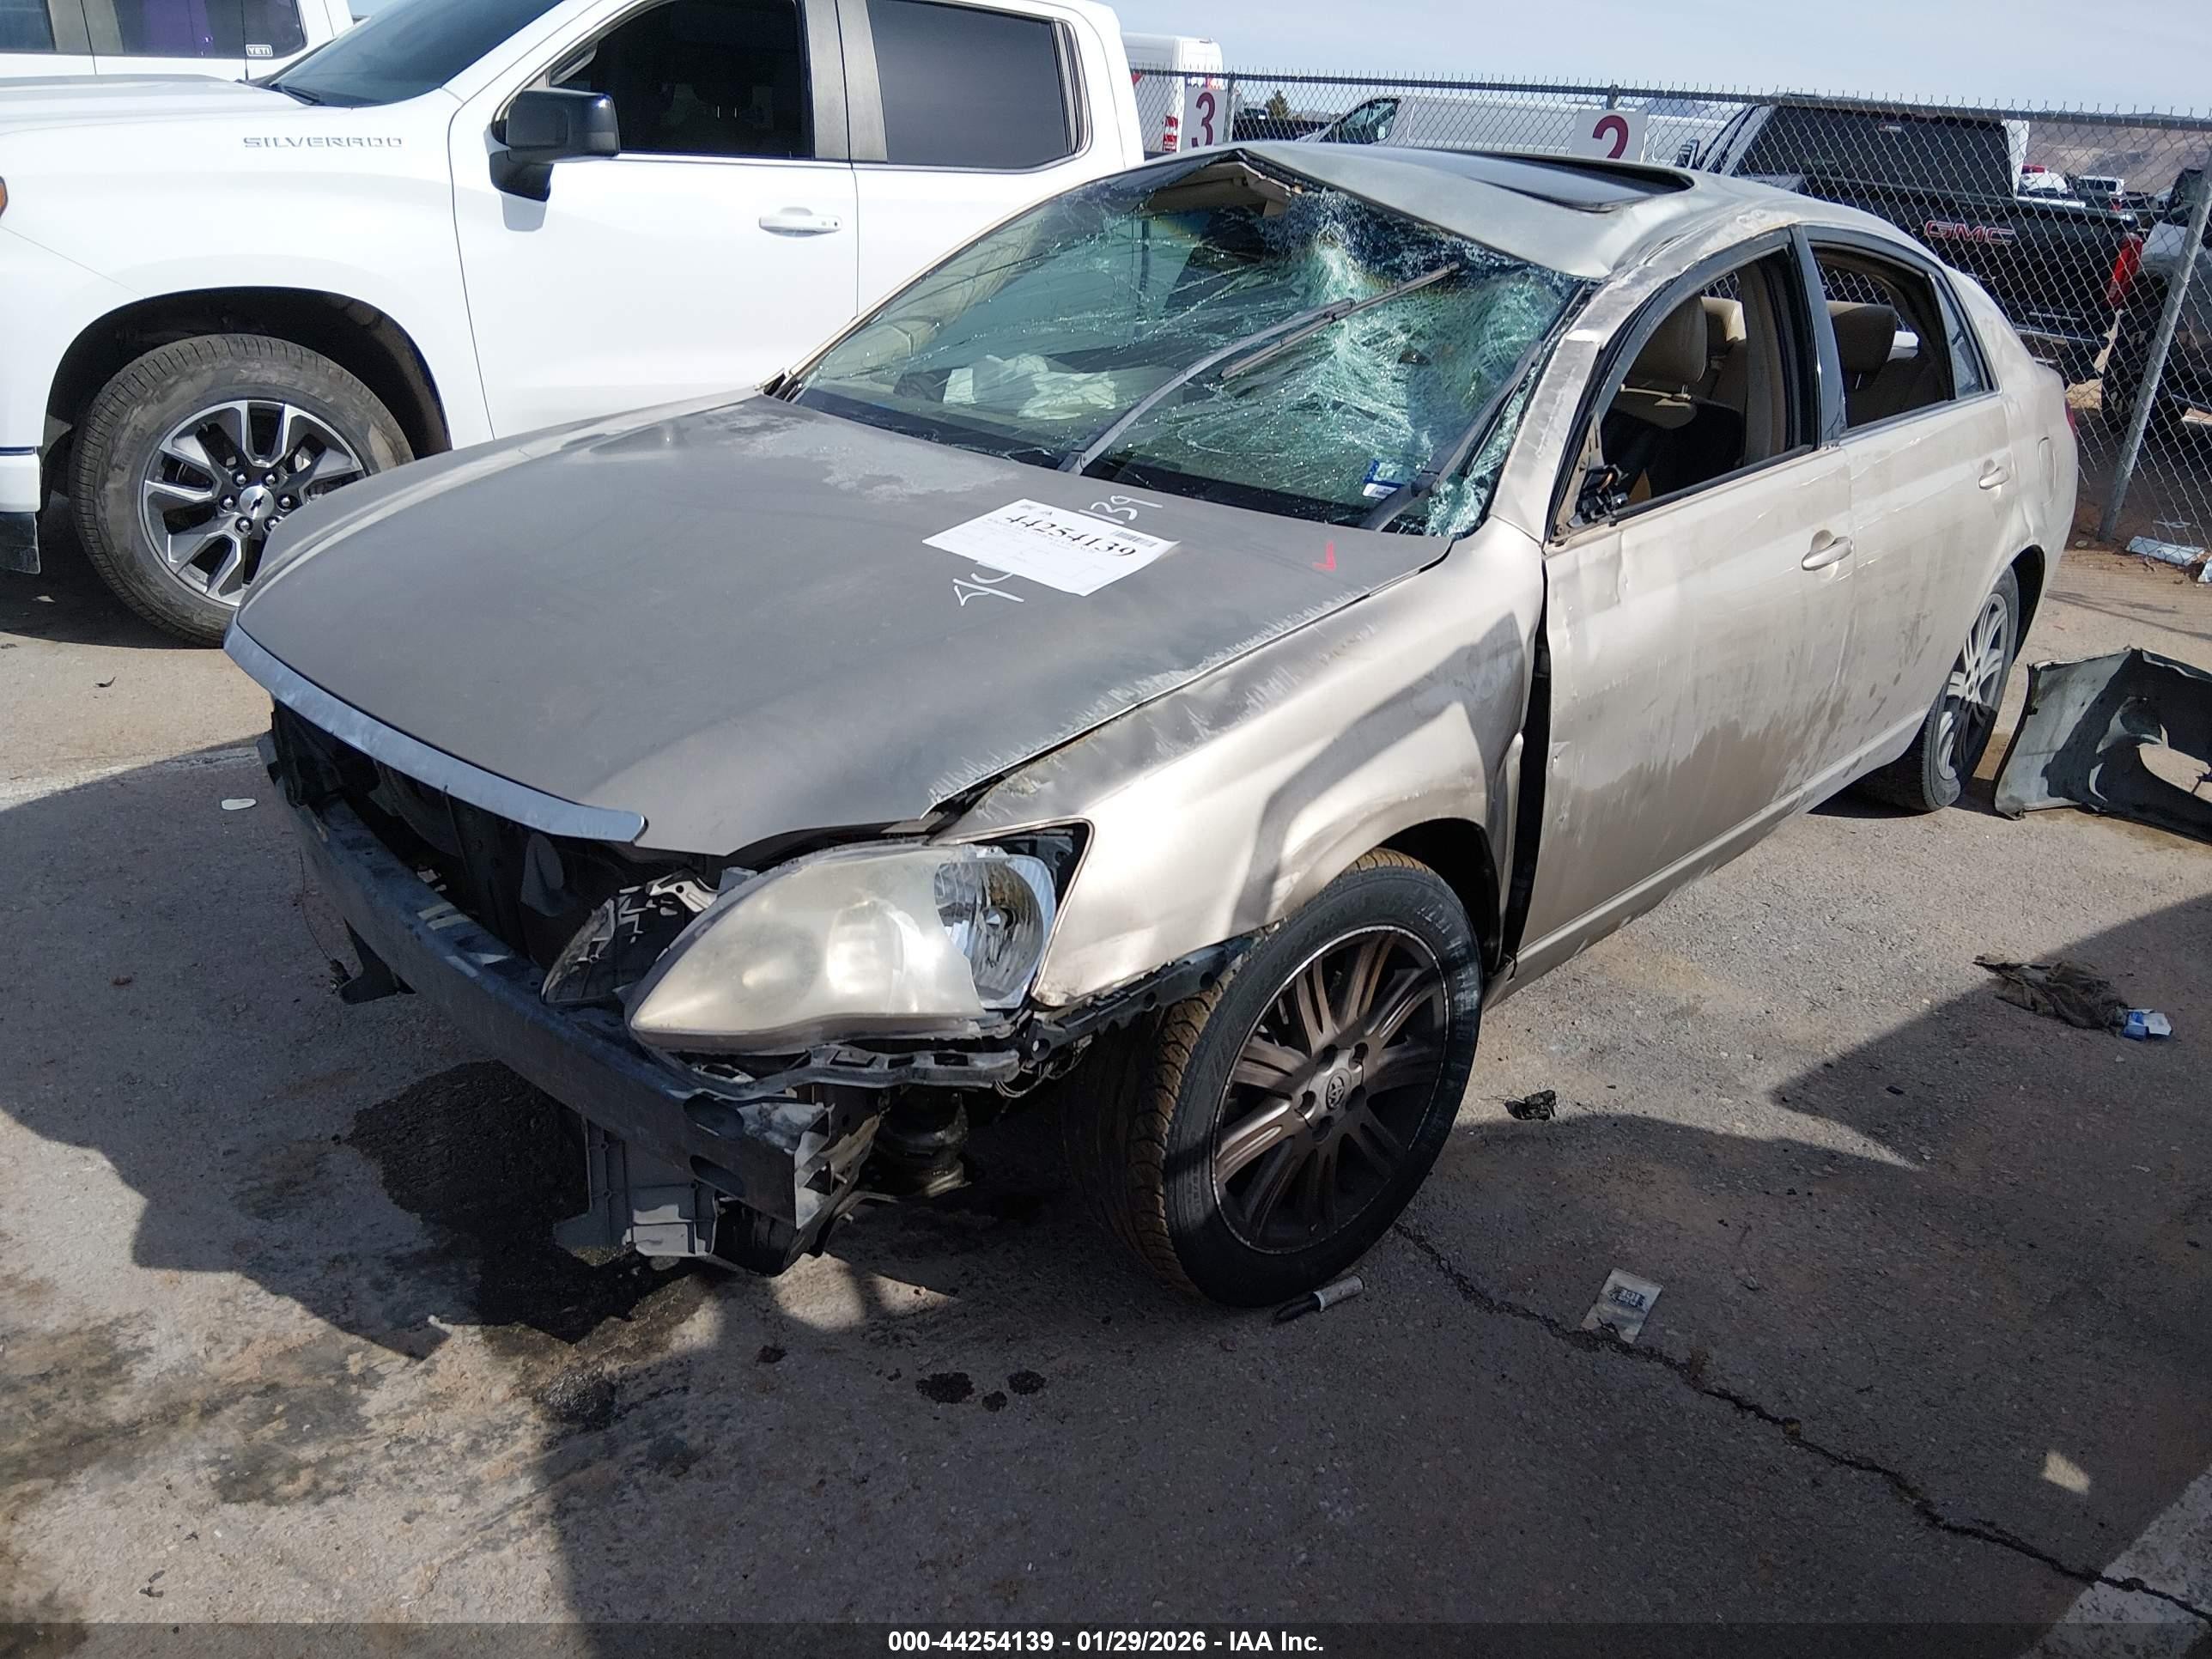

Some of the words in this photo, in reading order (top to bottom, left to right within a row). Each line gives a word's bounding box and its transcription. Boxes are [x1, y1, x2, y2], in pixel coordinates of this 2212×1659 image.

[247, 46, 270, 56] YETI
[1191, 92, 1216, 148] 3
[243, 137, 403, 148] SILVERADO
[1592, 114, 1629, 160] 2
[1924, 220, 2014, 246] GMC
[1006, 515, 1137, 556] 44254139
